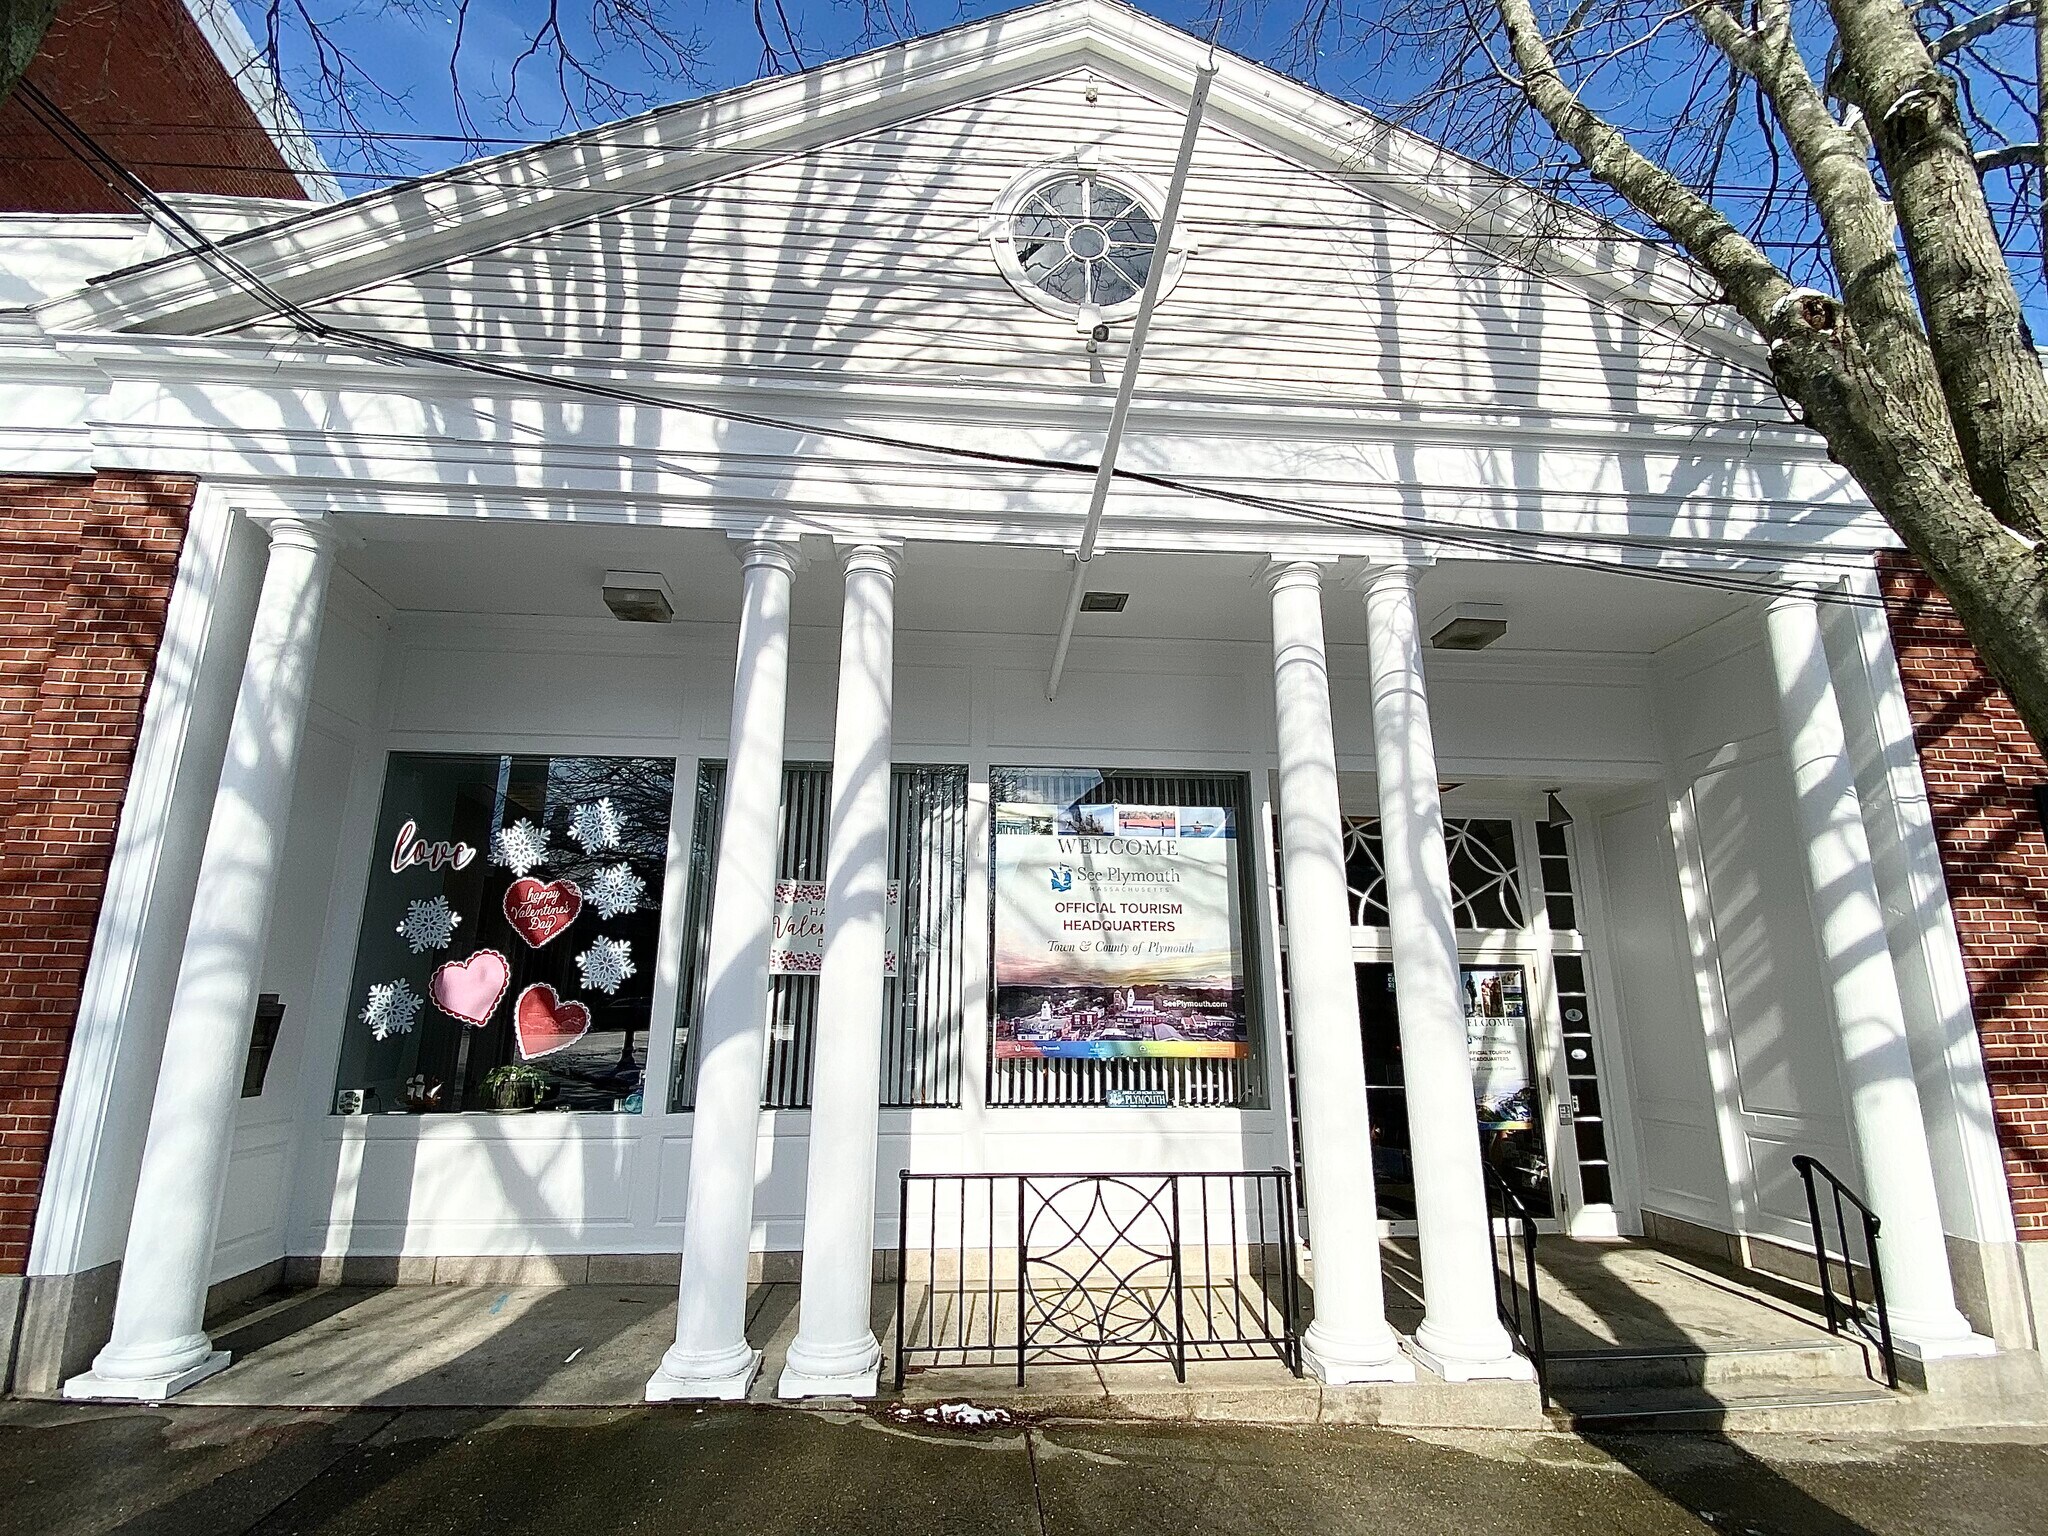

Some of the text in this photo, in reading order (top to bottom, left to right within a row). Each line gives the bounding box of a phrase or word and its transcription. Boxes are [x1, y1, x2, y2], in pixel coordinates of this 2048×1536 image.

[391, 820, 477, 874] love
[1057, 838, 1179, 856] WELCOME
[1077, 867, 1180, 886] See Plymouth
[520, 887, 561, 905] happy
[1055, 902, 1183, 915] OFFICIAL TOURISM
[528, 915, 557, 936] Day
[1063, 919, 1176, 932] HEADQUARTERS
[1047, 940, 1195, 957] Town & County of Plymouth
[1162, 1000, 1228, 1009] SeePlymouth.com
[1466, 1018, 1514, 1027] ELCOME
[1124, 1094, 1166, 1105] PLYMOUTH
